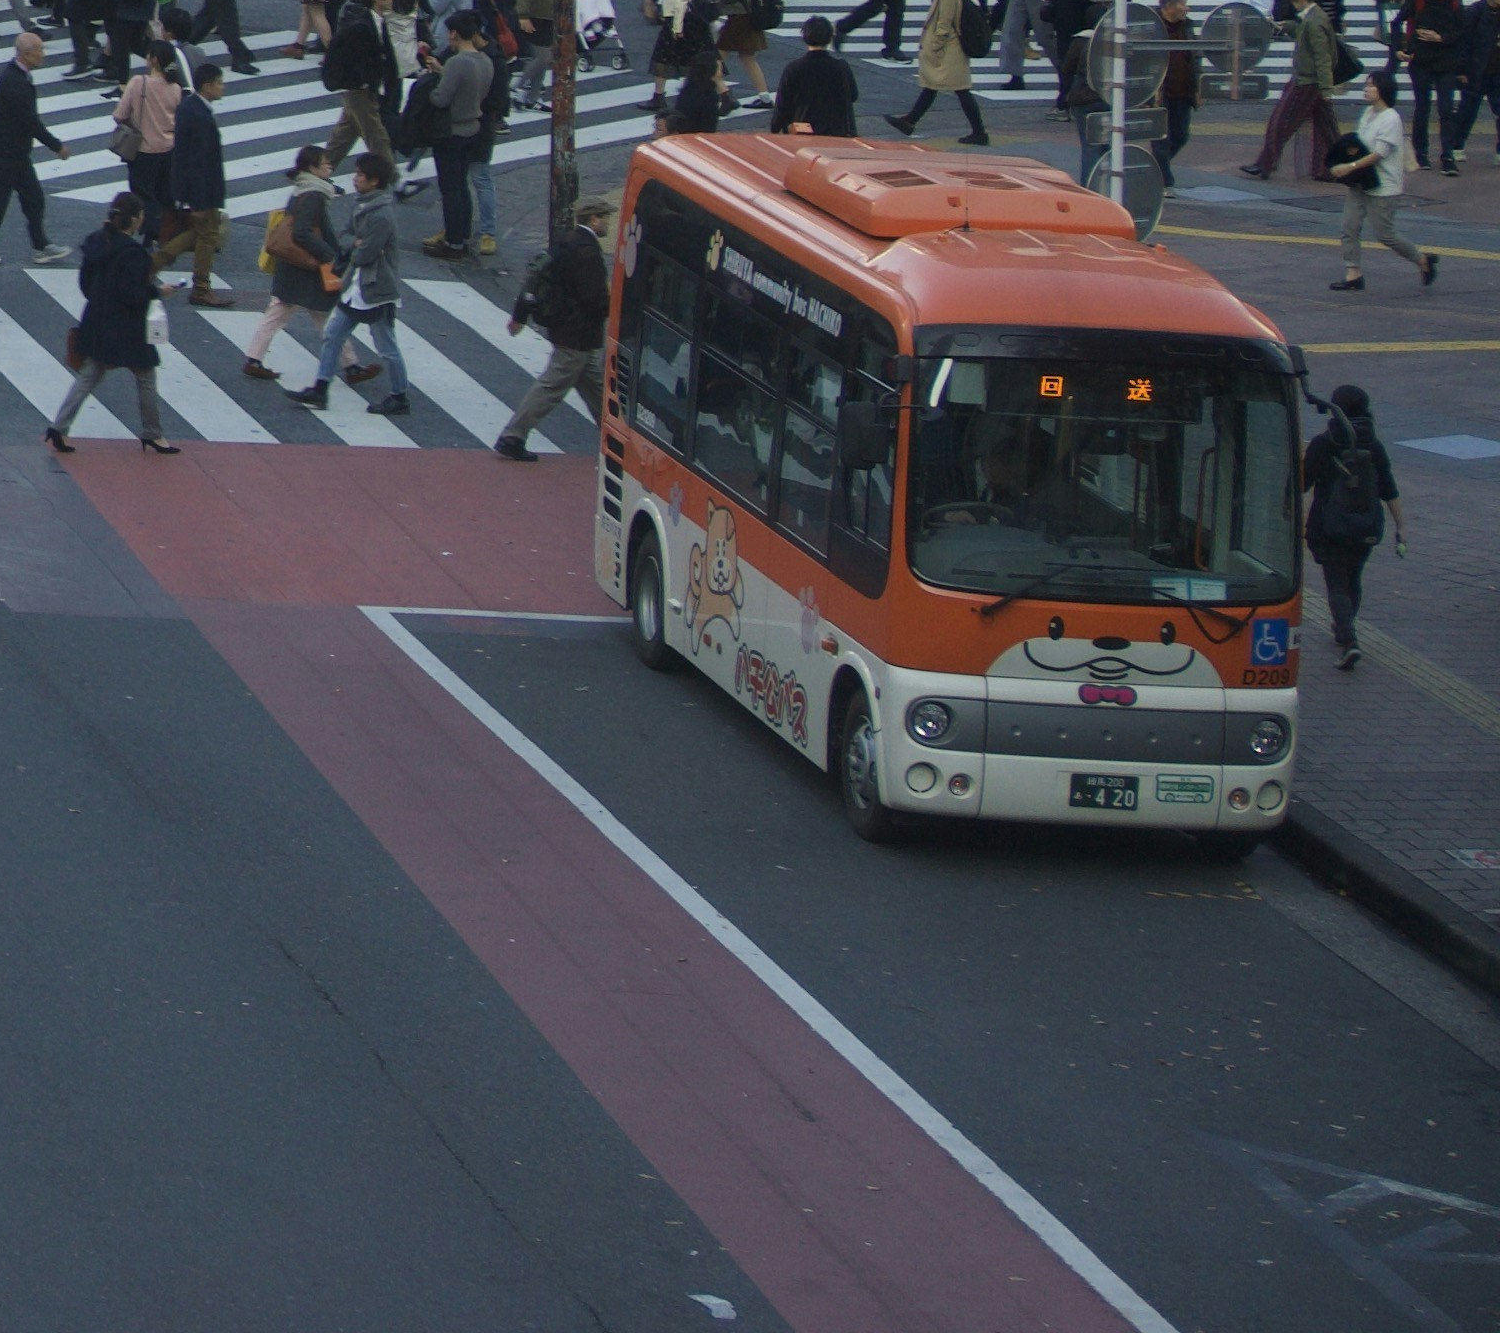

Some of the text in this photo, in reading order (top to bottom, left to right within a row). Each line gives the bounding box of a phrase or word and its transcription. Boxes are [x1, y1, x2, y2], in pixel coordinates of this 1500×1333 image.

[723, 245, 843, 339] SHIBUYA community bus HACHIKO
[1041, 375, 1152, 402] 回 送
[734, 641, 809, 750] ハチ公バス
[1241, 668, 1291, 686] D209
